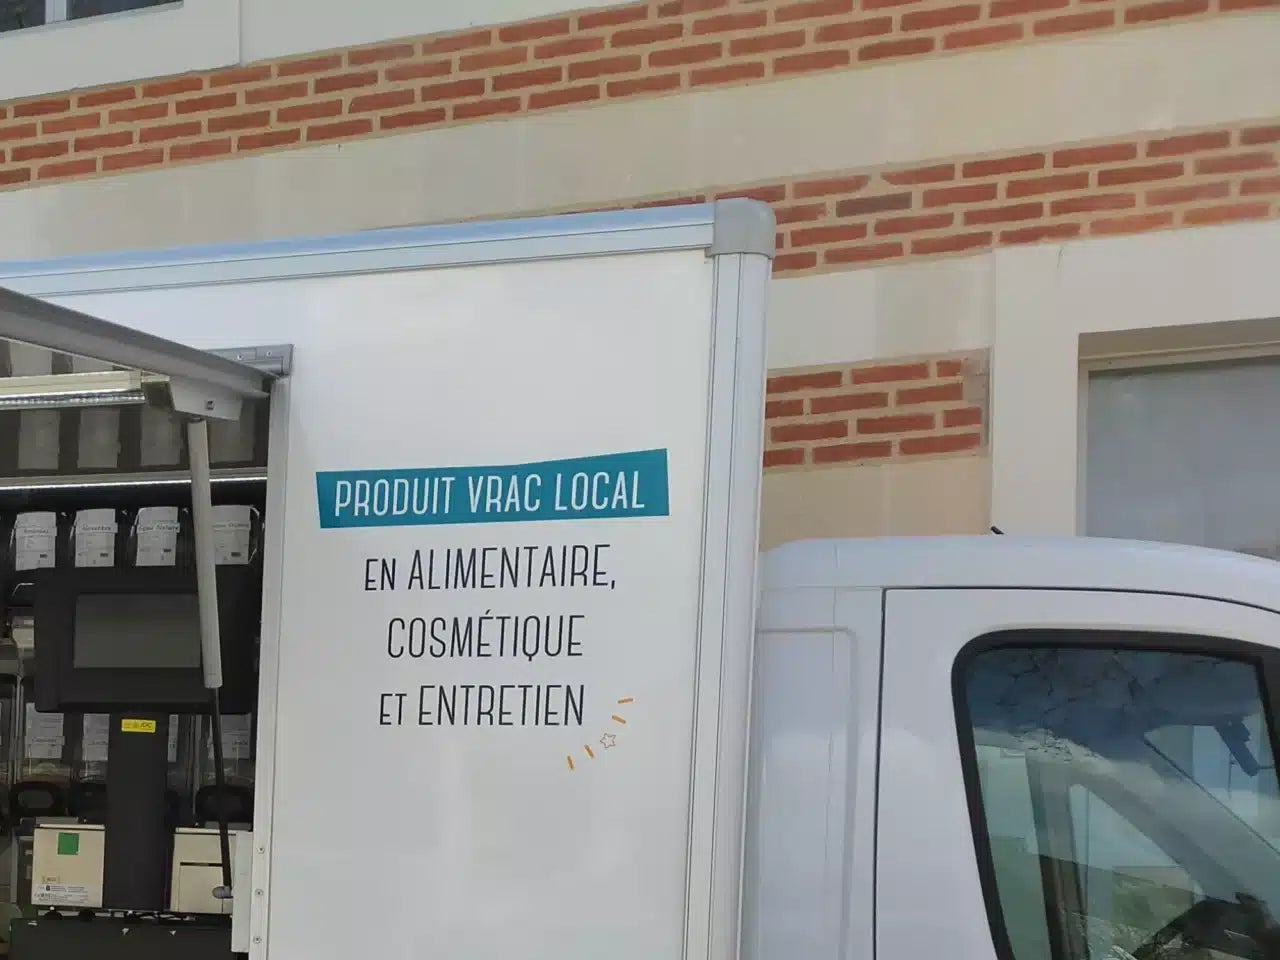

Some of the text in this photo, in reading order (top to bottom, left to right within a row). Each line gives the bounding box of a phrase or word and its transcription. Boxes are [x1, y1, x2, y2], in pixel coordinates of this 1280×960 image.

[334, 471, 646, 517] PRODUIT VRAC LOCAL
[364, 544, 617, 591] EN ALIMENTAIRE,
[387, 609, 586, 661] COSMÉTIQUE
[379, 684, 586, 726] ET ENTRETIEN
